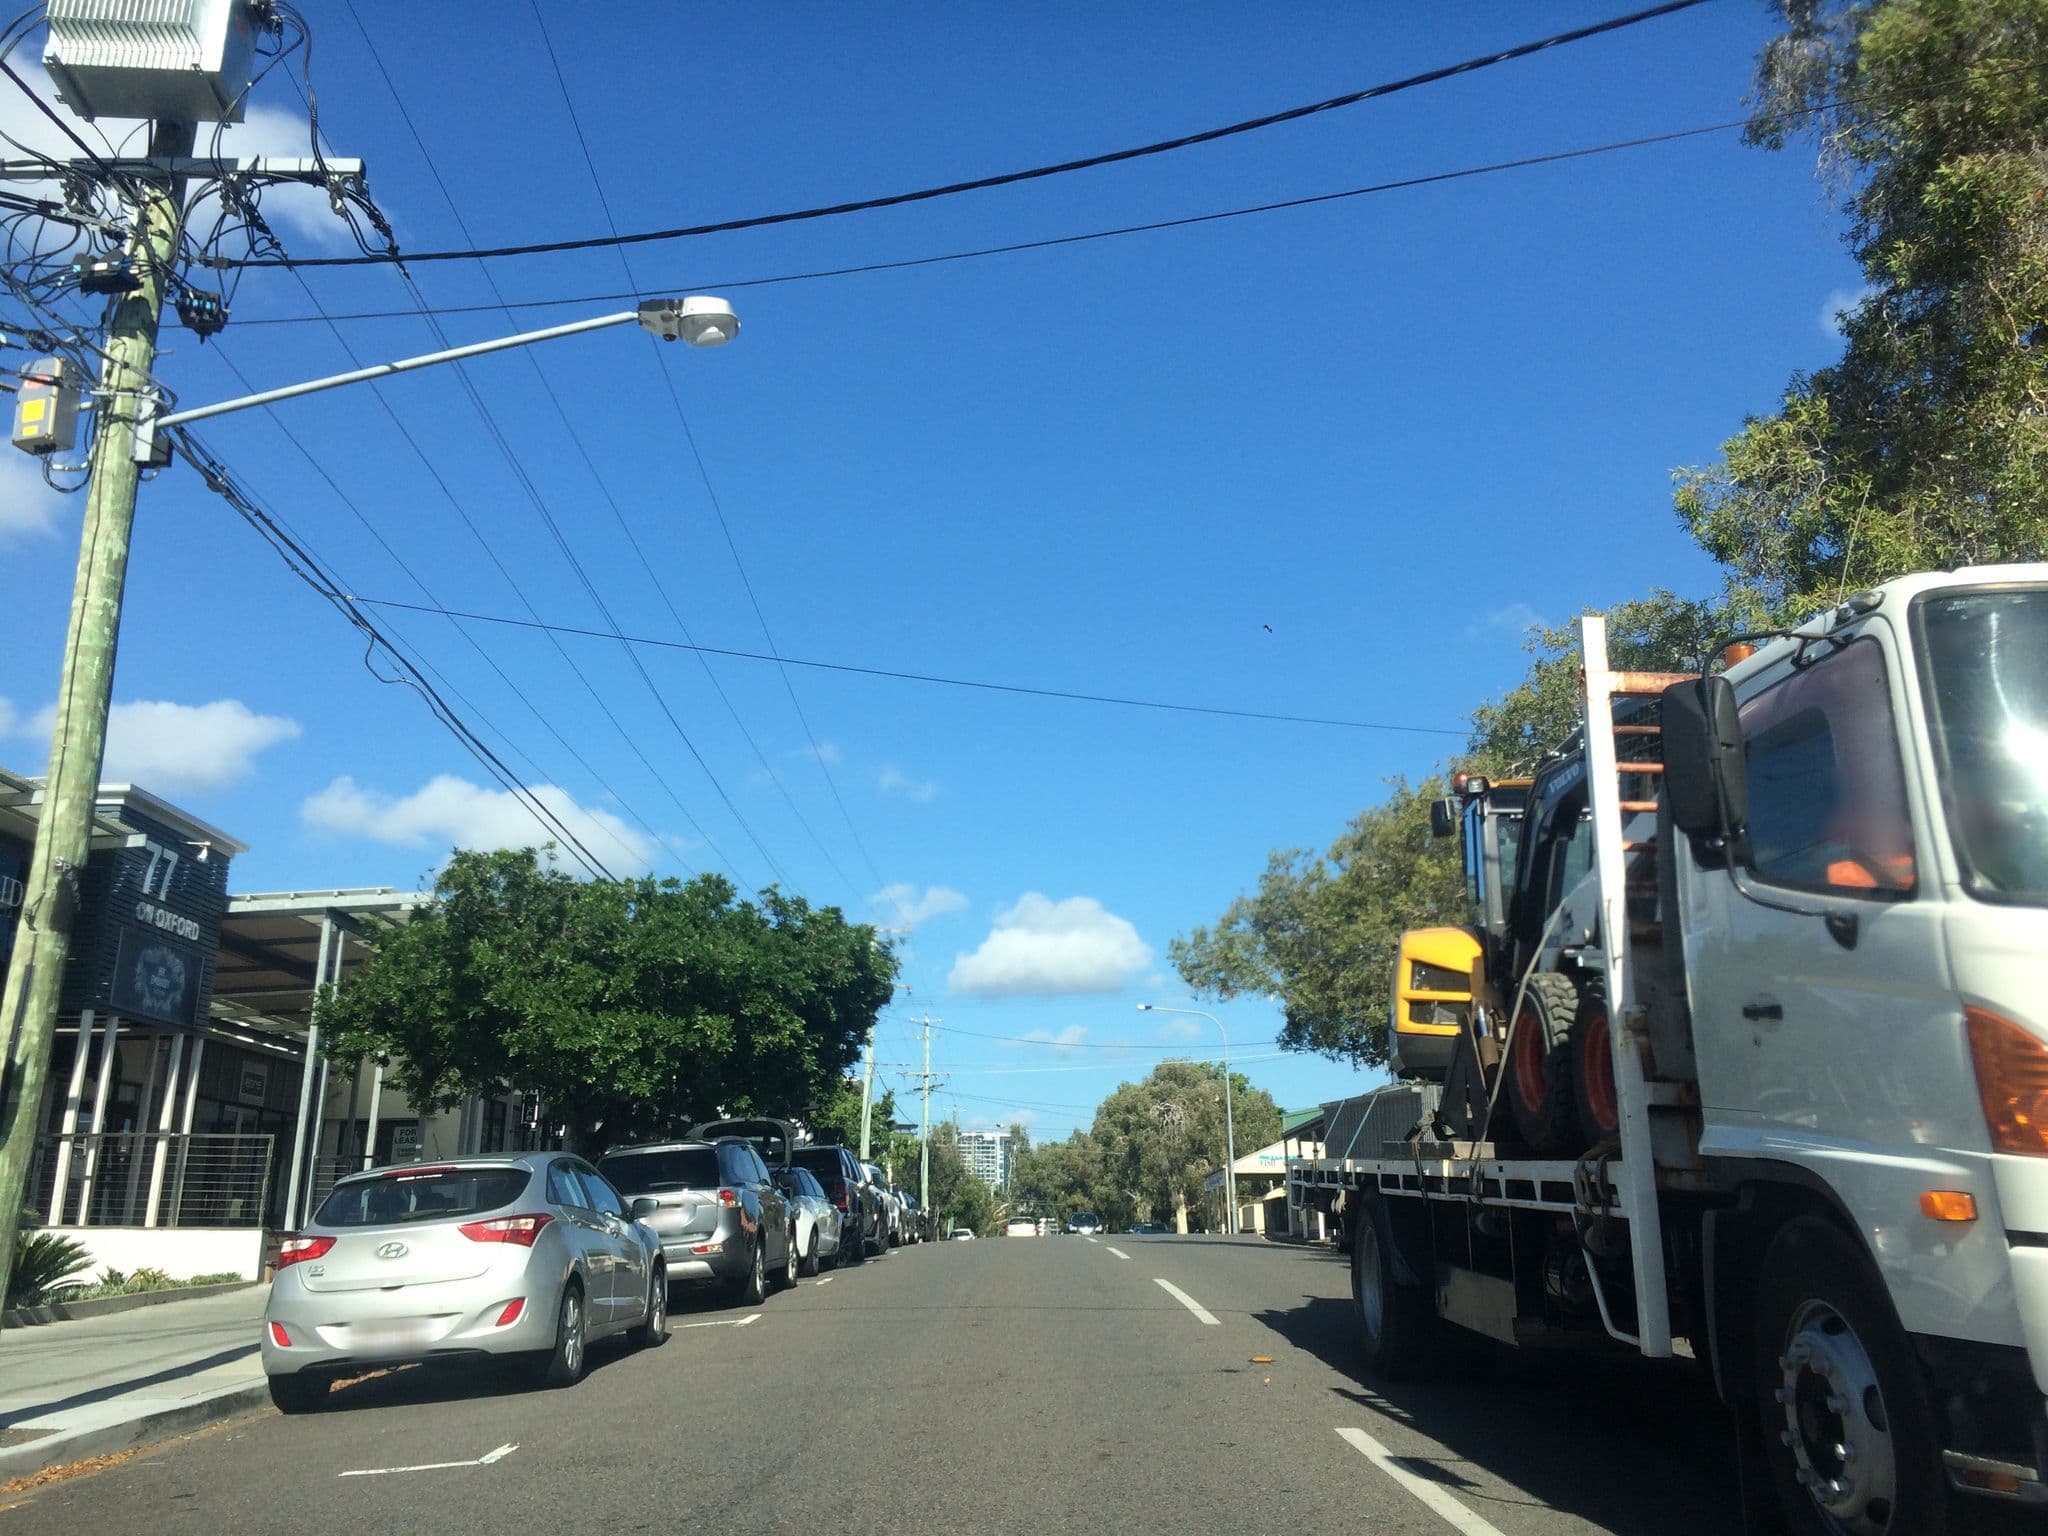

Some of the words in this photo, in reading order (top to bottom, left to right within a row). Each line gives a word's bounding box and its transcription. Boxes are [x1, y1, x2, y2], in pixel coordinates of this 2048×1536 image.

[1549, 763, 1580, 792] VOLVO
[142, 840, 178, 901] 77
[136, 902, 155, 924] ON
[155, 909, 199, 940] OXFORD
